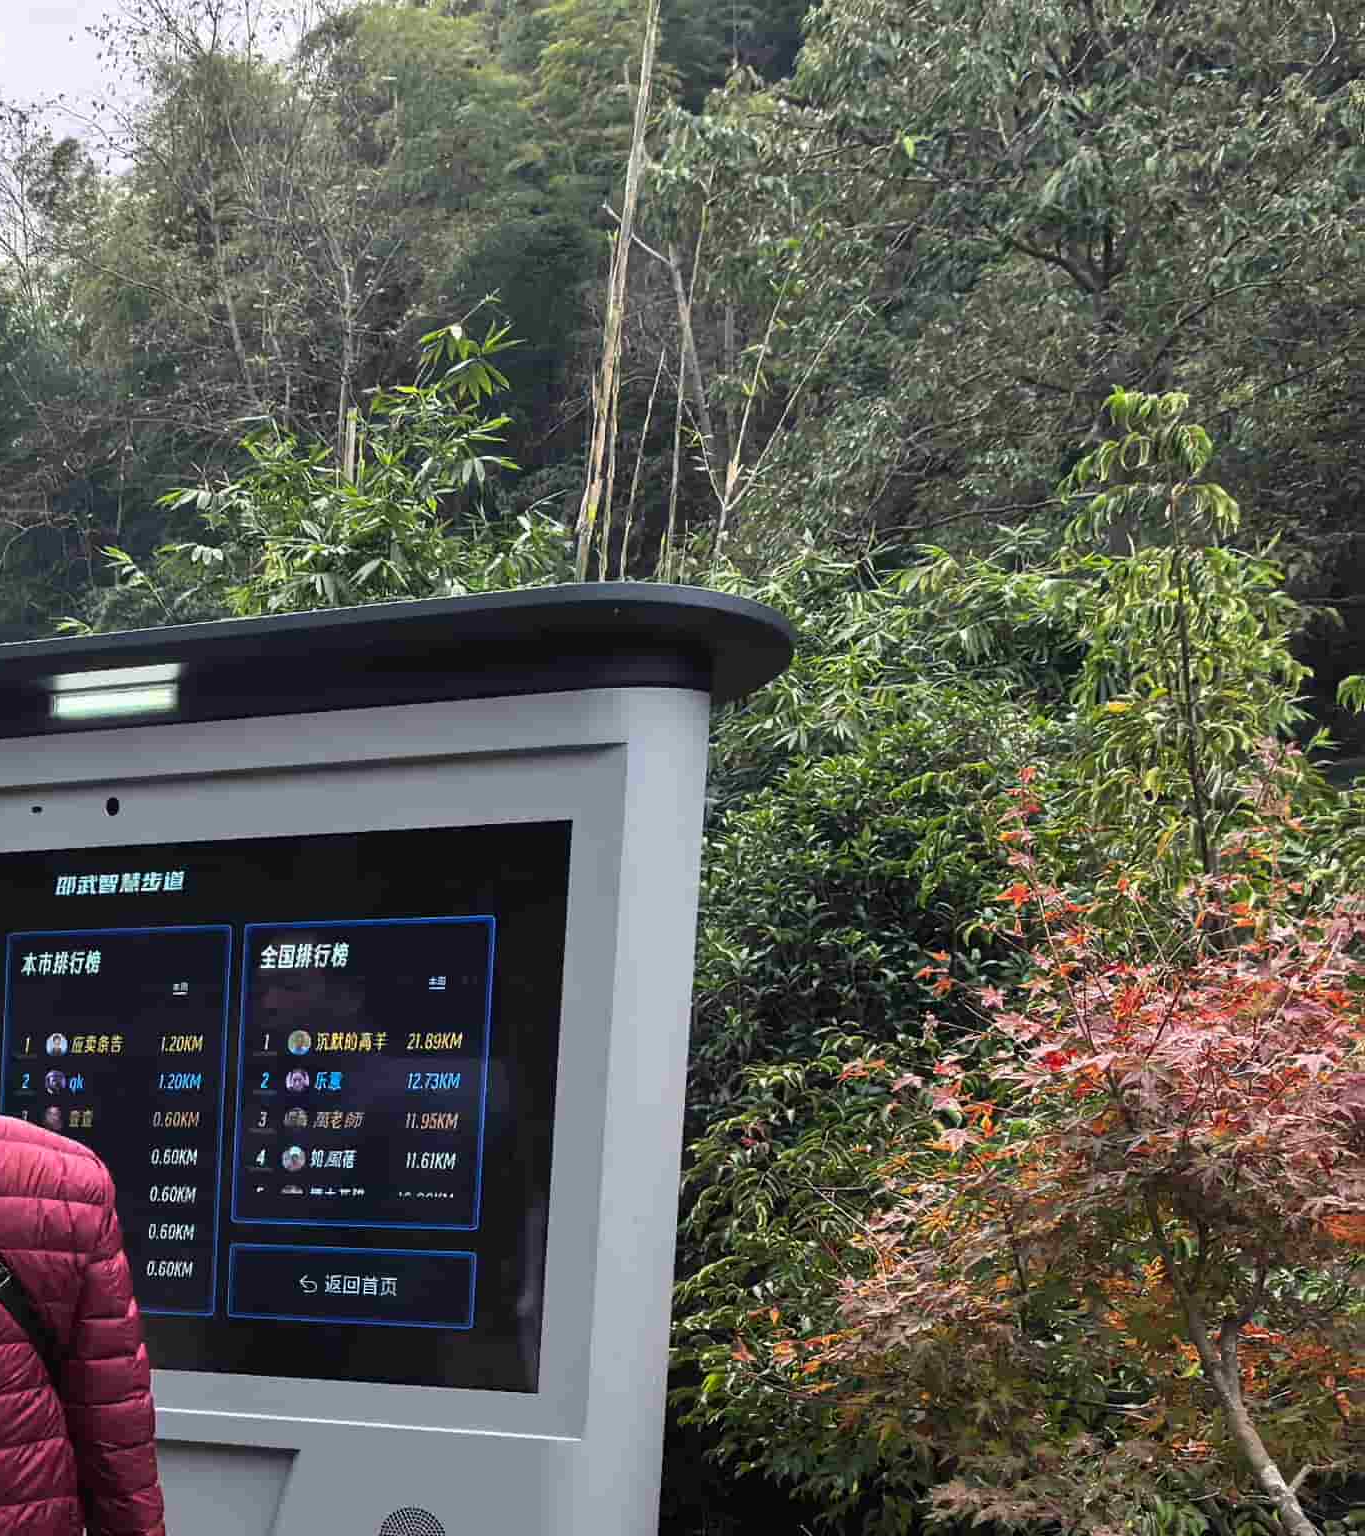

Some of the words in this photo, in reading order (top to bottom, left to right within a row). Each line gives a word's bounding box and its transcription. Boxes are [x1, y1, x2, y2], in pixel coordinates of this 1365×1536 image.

[55, 871, 185, 896] 邵武智慧步道
[21, 950, 102, 976] 本市排行榜
[260, 943, 350, 969] 全国排行榜
[161, 1034, 204, 1053] 1.20KM
[406, 1031, 464, 1051] 21.89KM
[22, 1072, 31, 1089] 2
[158, 1072, 203, 1090] 1.20KM
[260, 1071, 270, 1089] 2
[406, 1072, 462, 1090] 12.73KM
[152, 1111, 200, 1128] 0.60KM
[258, 1111, 268, 1128] 3
[405, 1112, 460, 1129] 11.95KM
[150, 1148, 198, 1166] 0.60KM
[255, 1149, 266, 1165] 4
[405, 1151, 457, 1170] 11.61KM
[149, 1185, 197, 1203] 0.60KM
[148, 1223, 195, 1241] 0.60KM
[147, 1260, 194, 1278] 0.60KM
[324, 1274, 398, 1296] 返回首页
